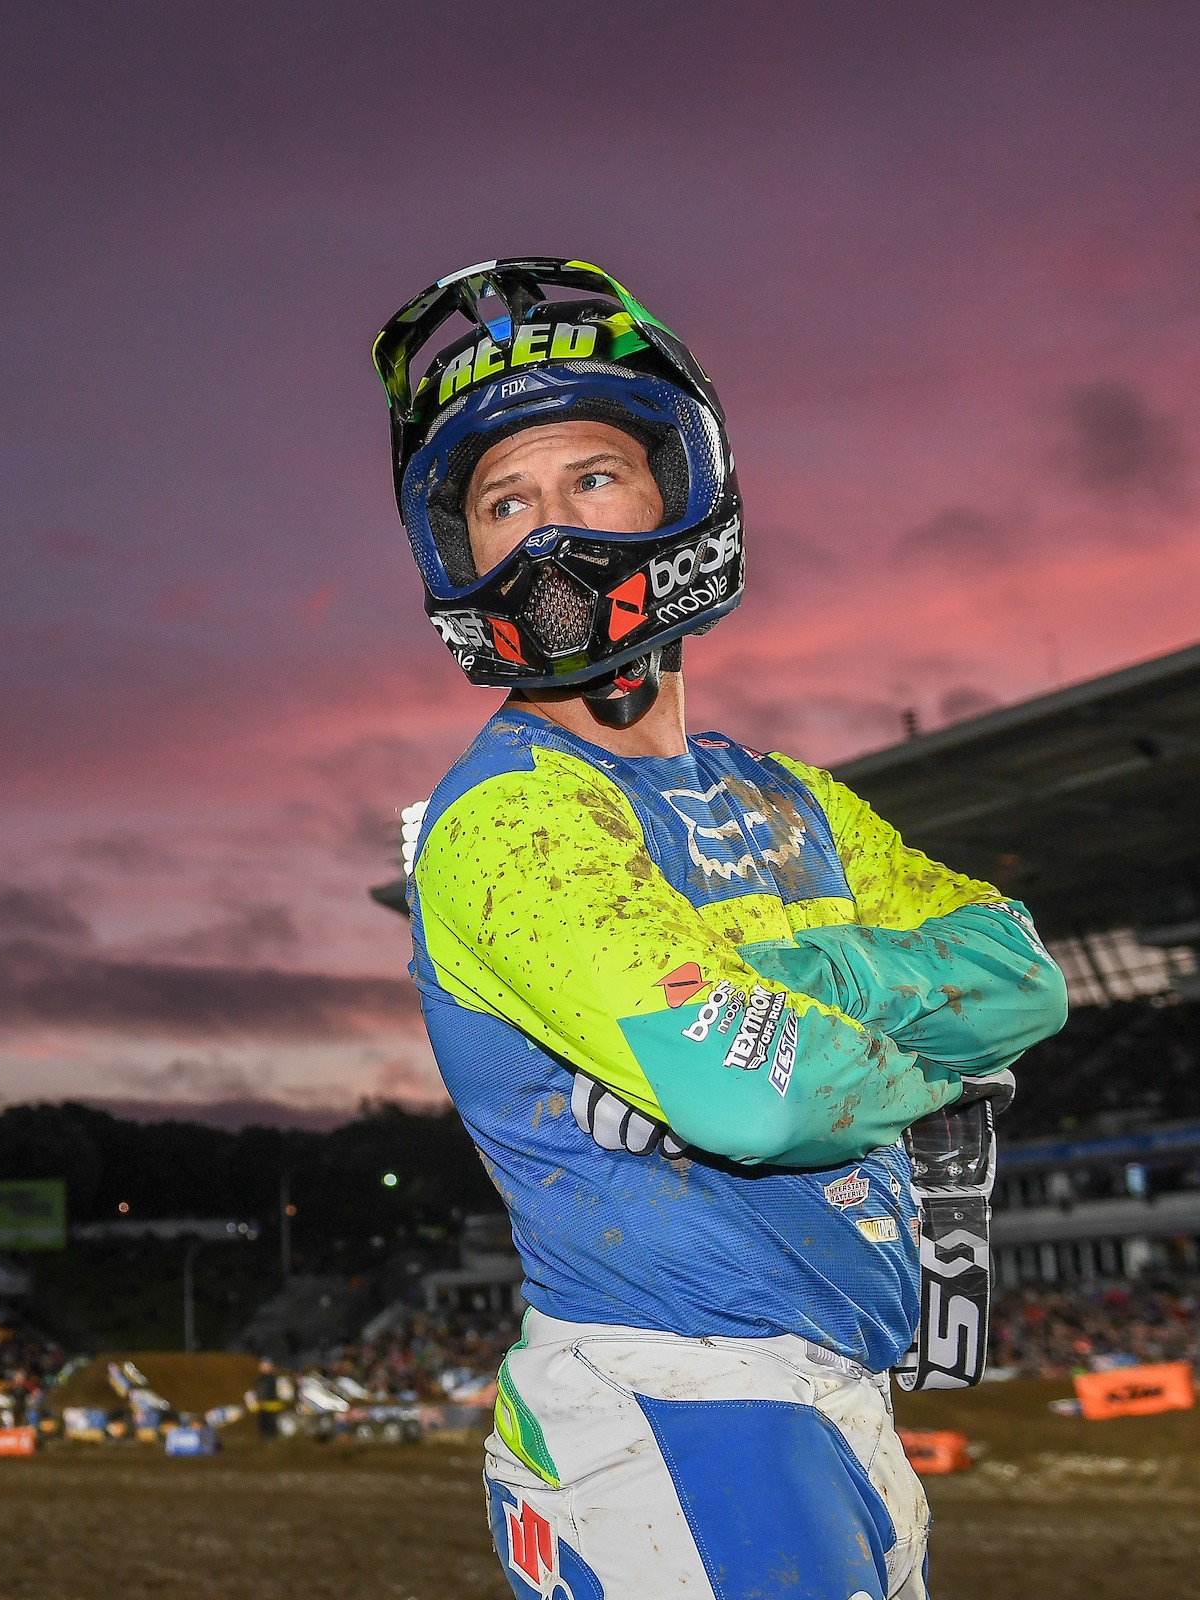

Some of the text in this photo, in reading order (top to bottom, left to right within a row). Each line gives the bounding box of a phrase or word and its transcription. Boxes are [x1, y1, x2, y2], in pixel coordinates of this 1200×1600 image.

[439, 322, 598, 405] REED
[501, 378, 526, 398] FOX
[649, 513, 740, 598] boost
[656, 575, 728, 623] mobile
[681, 979, 737, 1042] boost
[716, 991, 746, 1034] mobile
[722, 982, 774, 1068] TEXTRON
[761, 992, 785, 1044] OFF ROAD
[826, 1181, 867, 1195] INTERSTATE
[830, 1189, 866, 1202] BATTERIES
